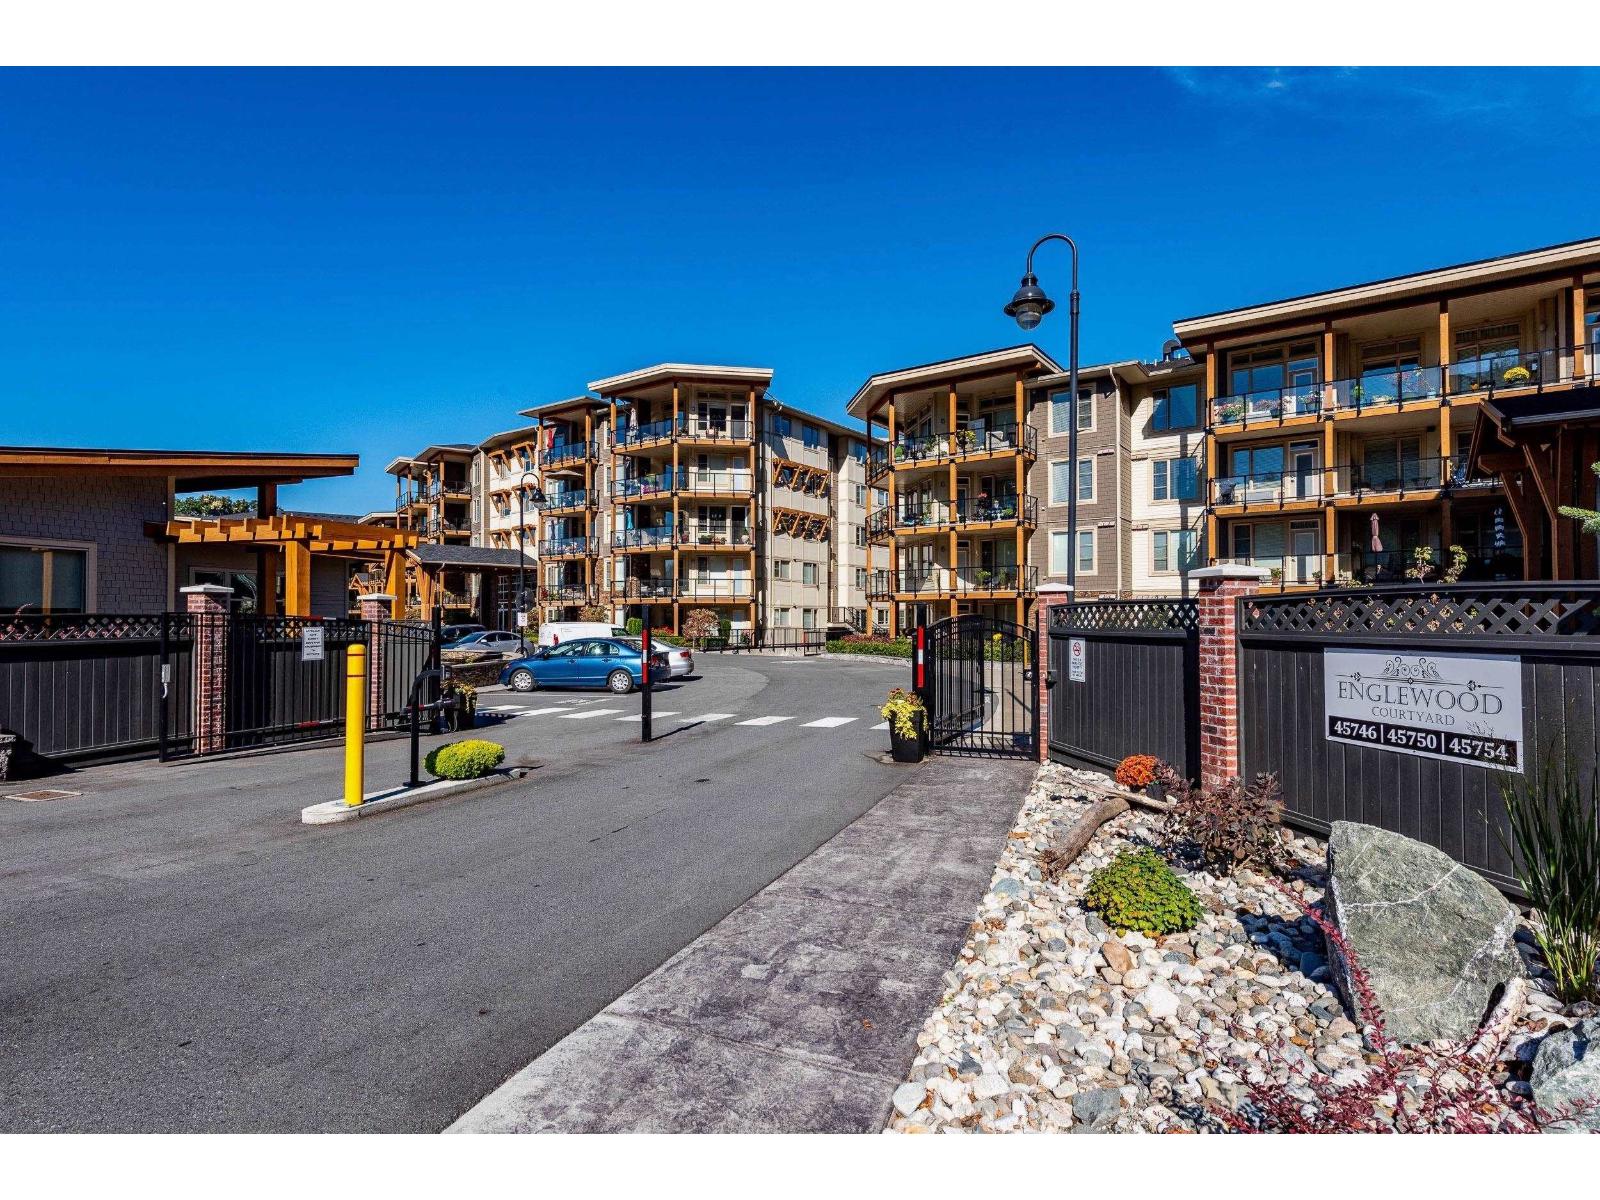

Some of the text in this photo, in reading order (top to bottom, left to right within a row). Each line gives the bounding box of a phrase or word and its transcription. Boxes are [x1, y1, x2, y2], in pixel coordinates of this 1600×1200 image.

[1337, 681, 1503, 715] ENGLEWOOD
[1371, 706, 1455, 726] COURTYARD
[1334, 720, 1509, 761] 45746 45750 45754
